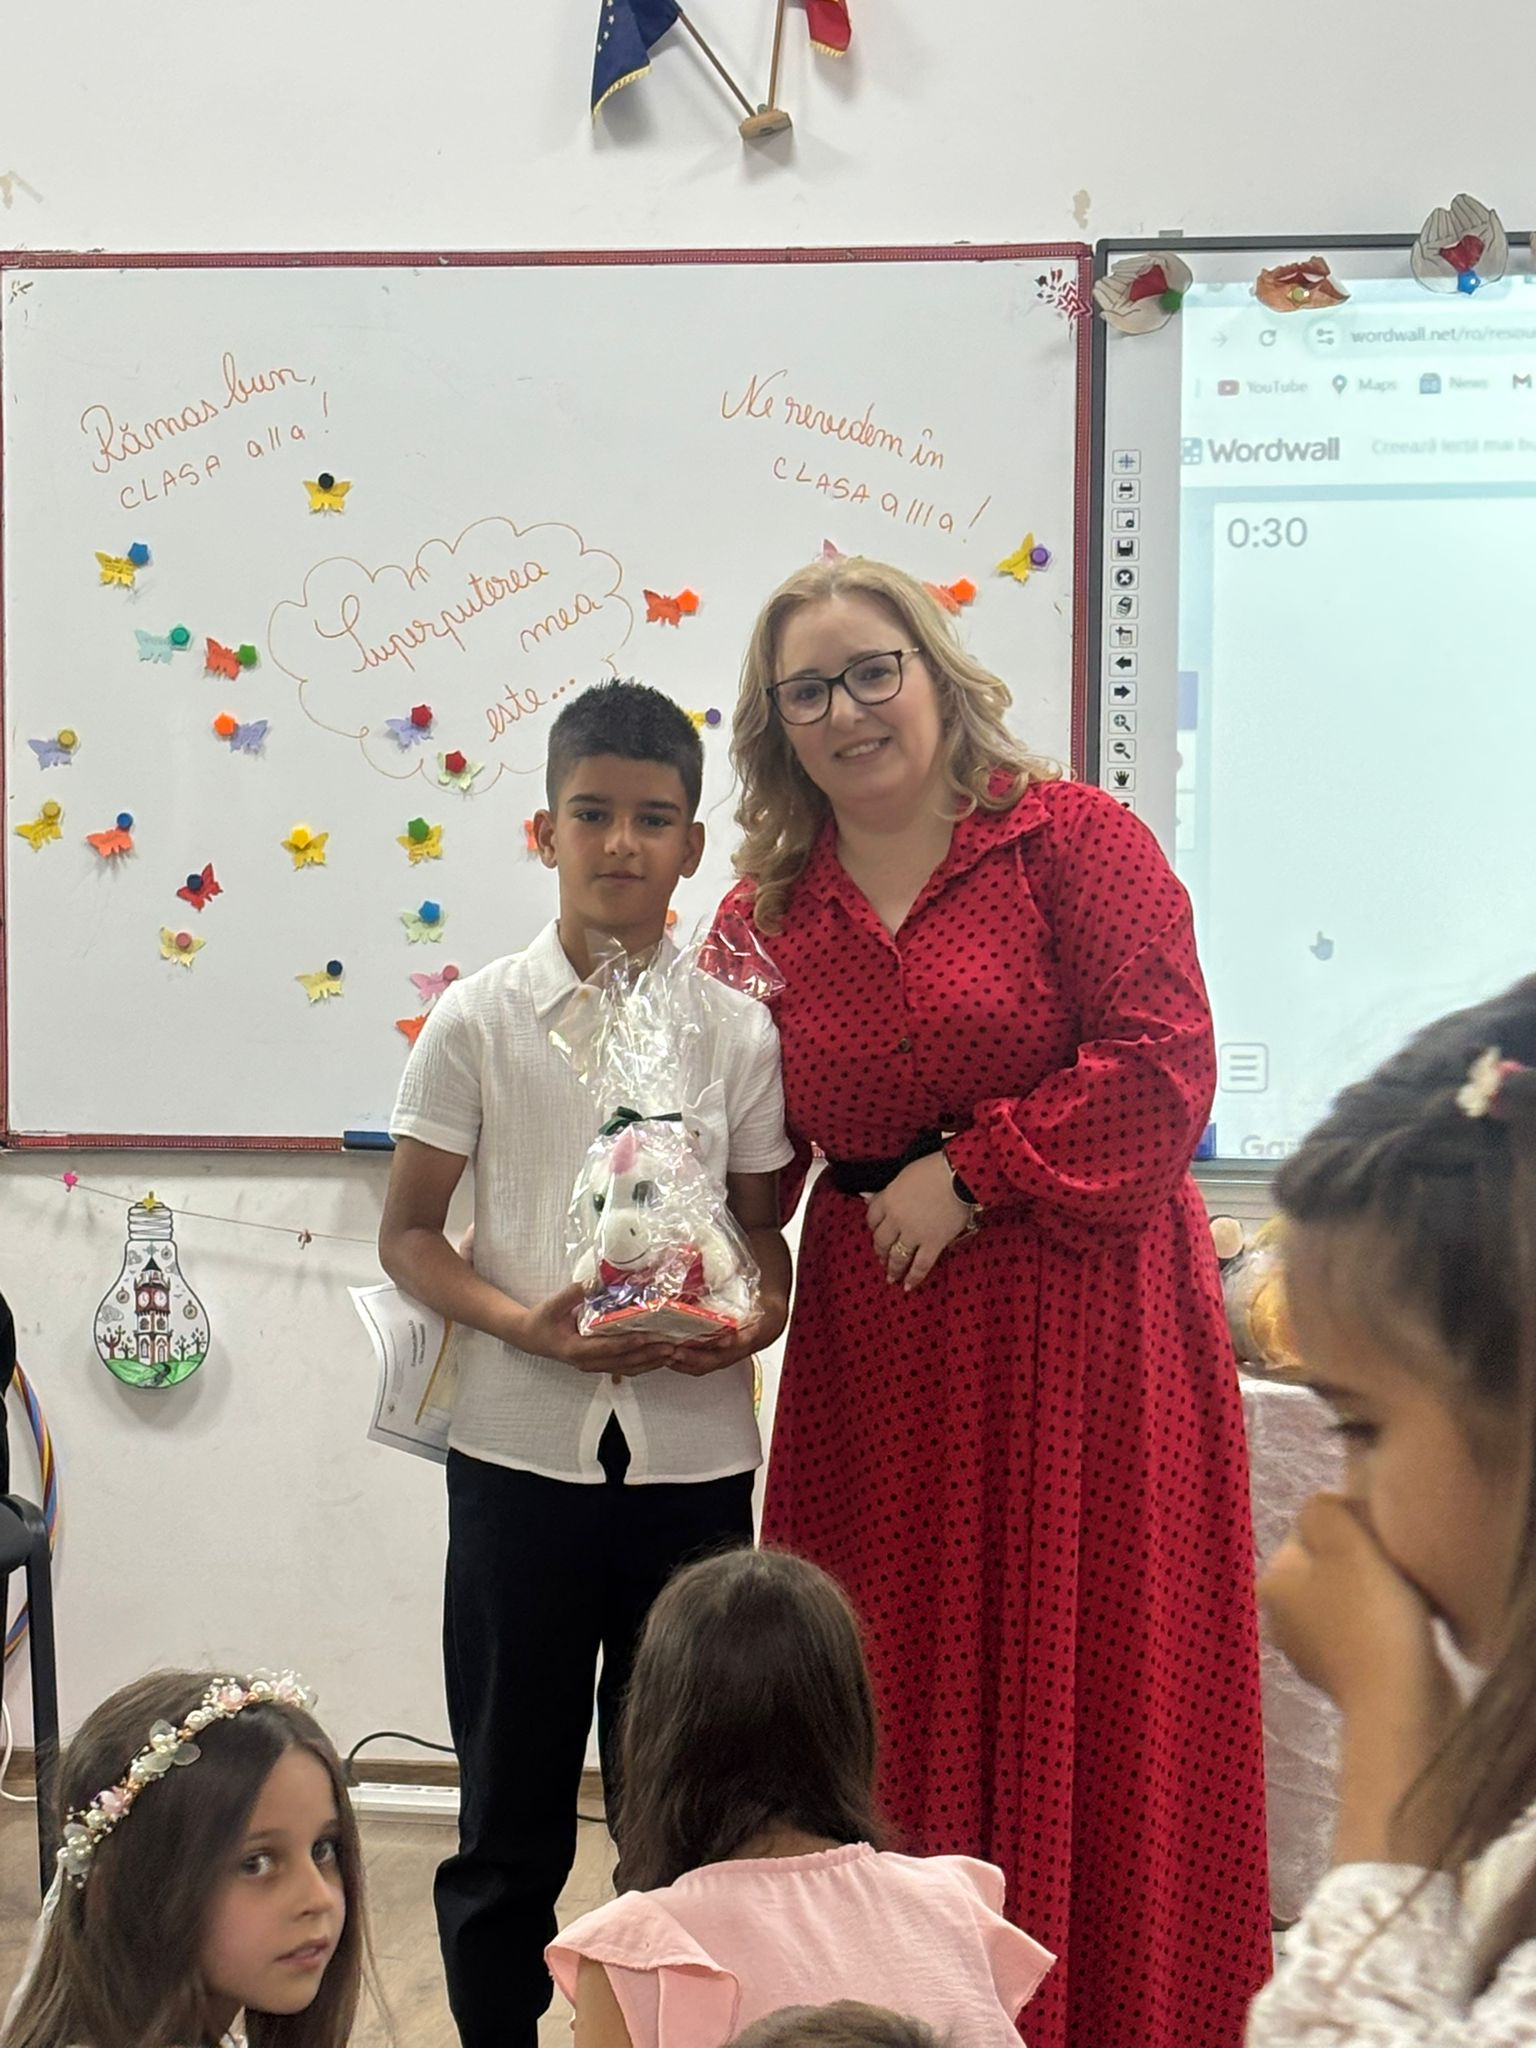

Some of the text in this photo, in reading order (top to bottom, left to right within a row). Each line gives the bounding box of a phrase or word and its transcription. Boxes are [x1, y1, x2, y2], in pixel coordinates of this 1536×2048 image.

[1247, 379, 1309, 395] YouTube
[1358, 378, 1398, 393] Maps
[80, 399, 219, 474] Rămas
[721, 368, 944, 469] Ne revedem în
[1208, 436, 1341, 463] Wordwall
[119, 454, 221, 510] CLASA
[773, 456, 870, 504] CLASA
[1227, 517, 1308, 549] 0:30
[314, 561, 549, 674] Superputerea
[520, 593, 603, 653] mea
